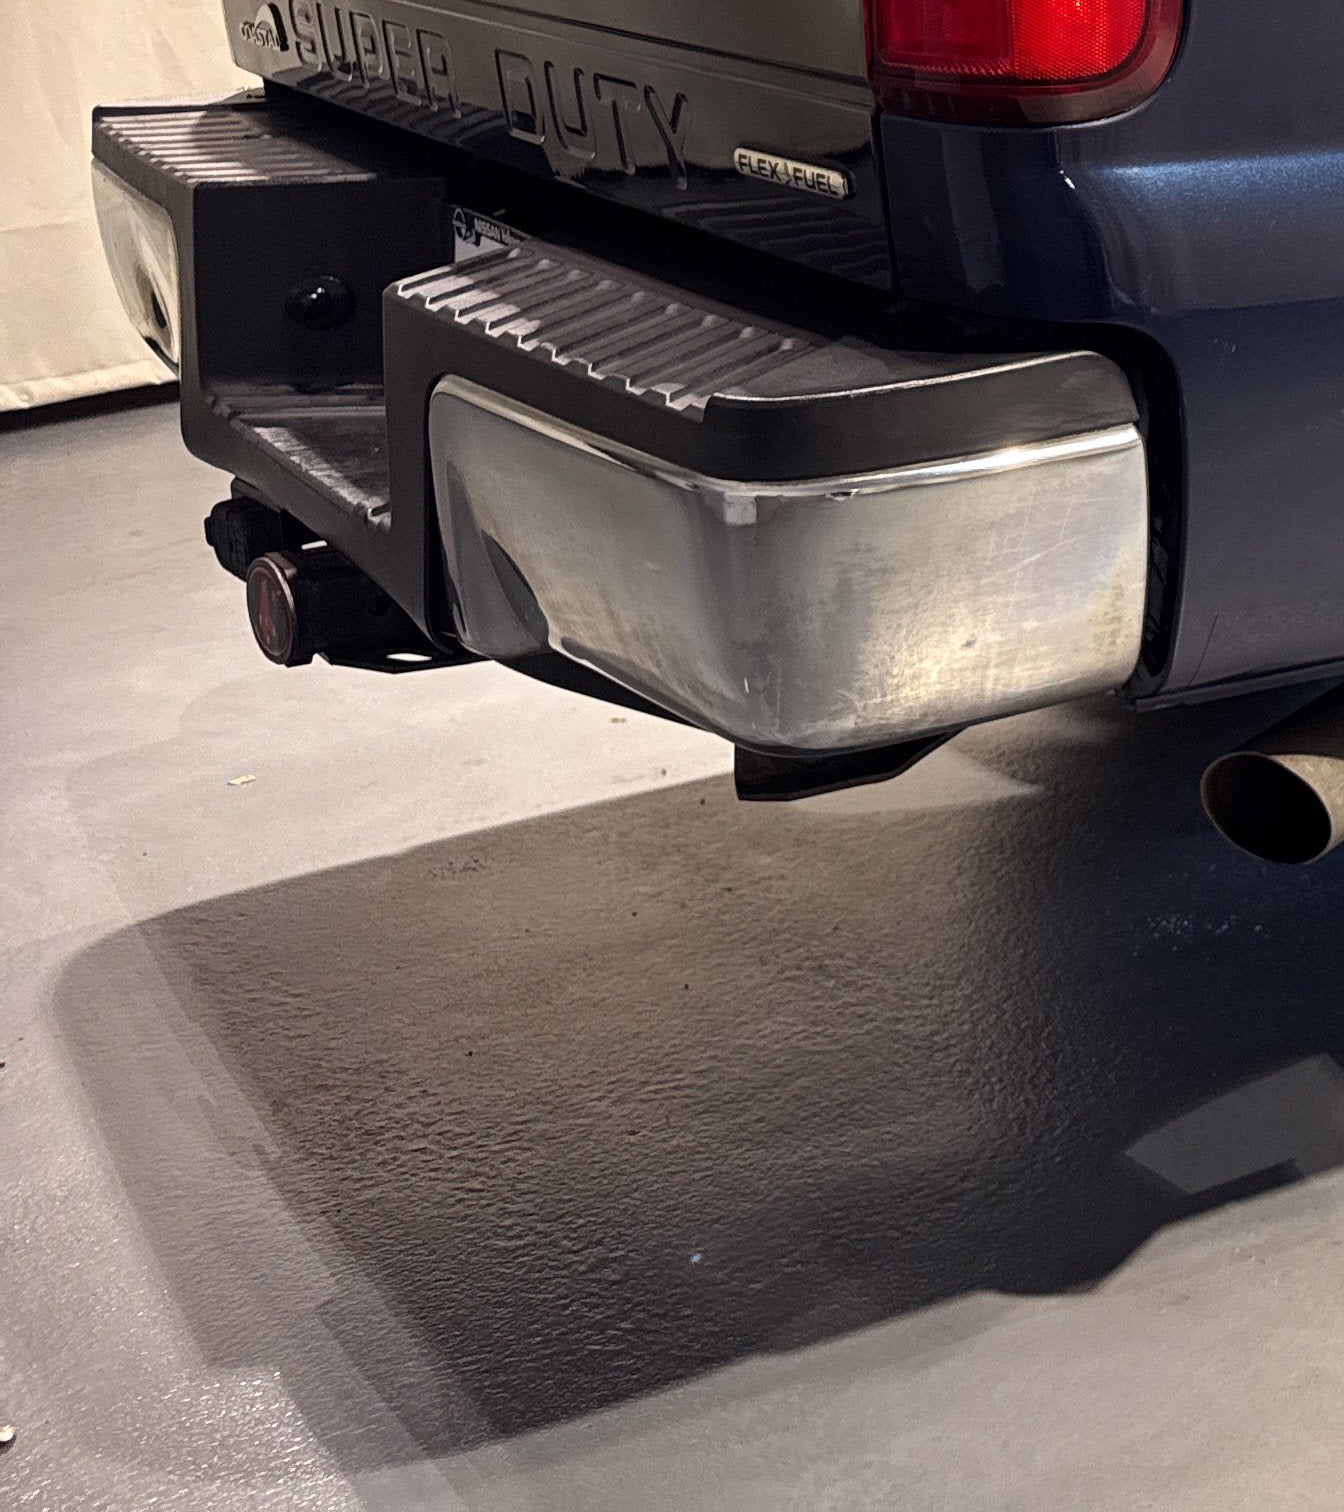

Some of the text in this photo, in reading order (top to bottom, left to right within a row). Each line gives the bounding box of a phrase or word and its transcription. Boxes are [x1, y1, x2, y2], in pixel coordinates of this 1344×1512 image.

[495, 48, 689, 190] DUTY
[738, 153, 839, 196] FLEX FUEL
